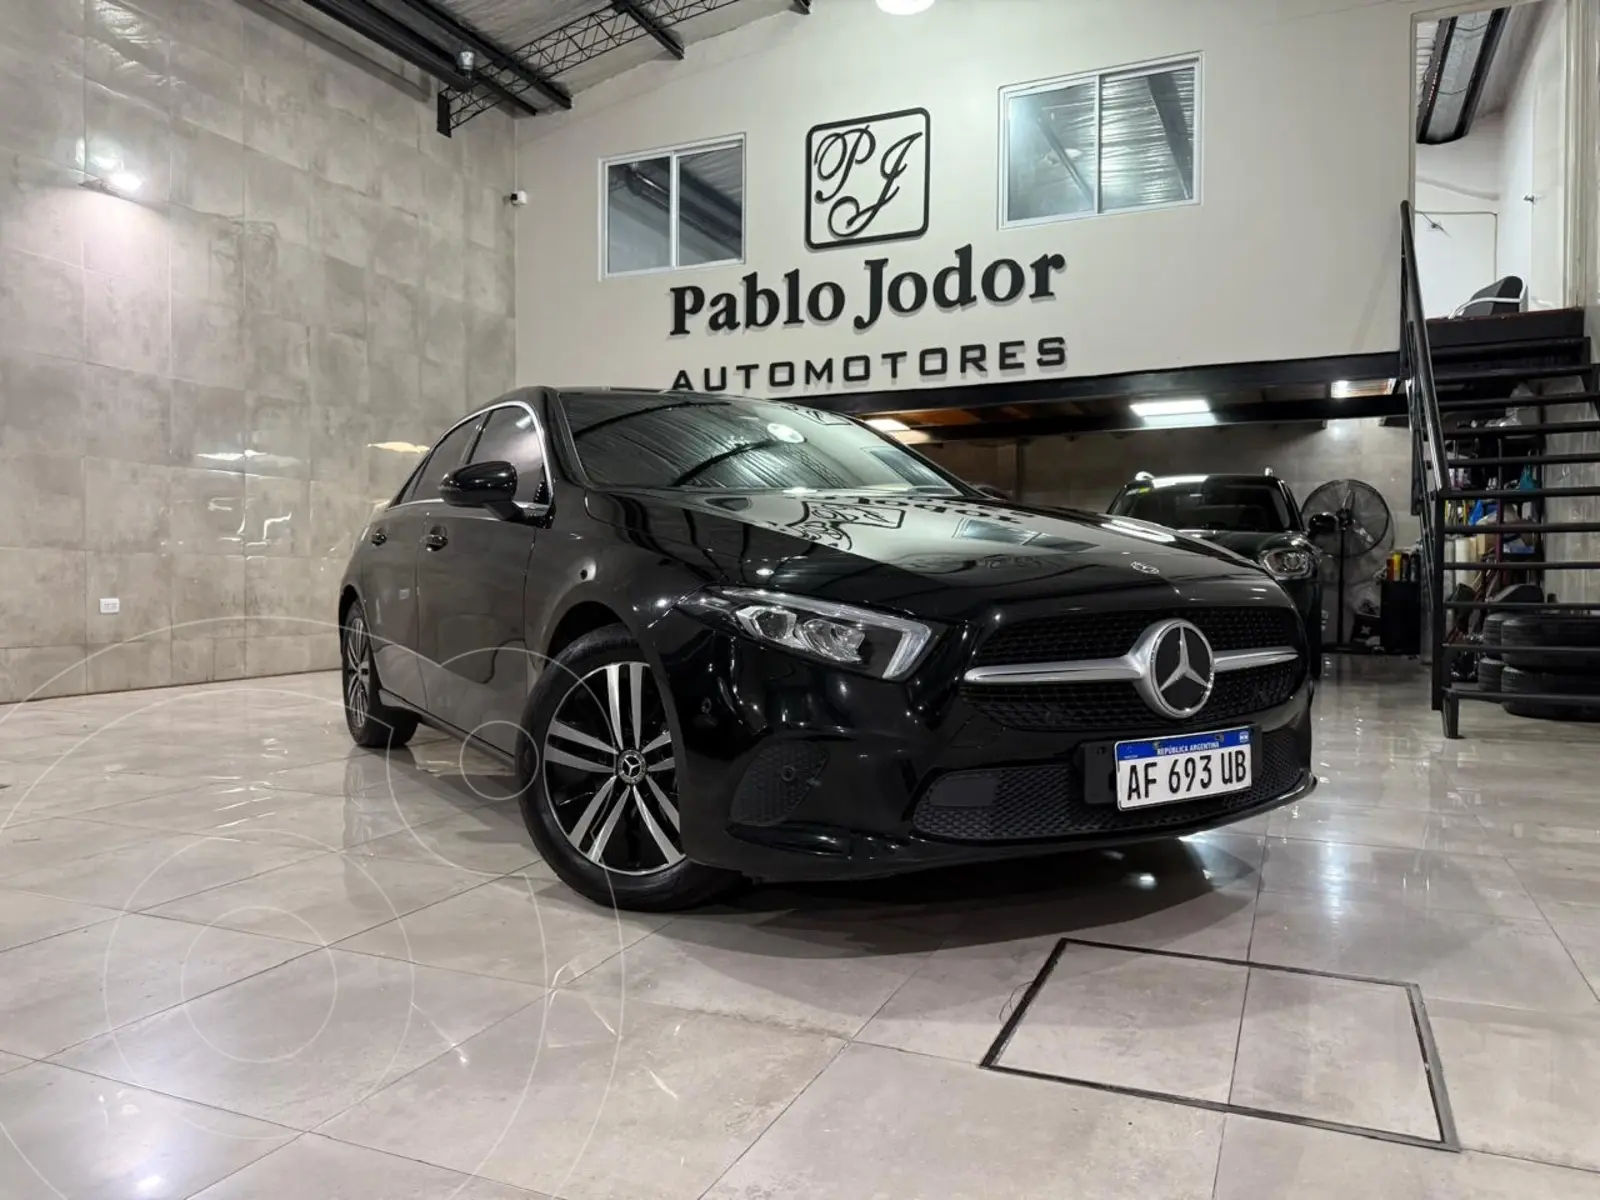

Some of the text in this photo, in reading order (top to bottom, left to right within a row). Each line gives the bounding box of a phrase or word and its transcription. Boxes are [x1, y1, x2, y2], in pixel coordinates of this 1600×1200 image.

[669, 243, 1066, 336] Pablo Jodor
[671, 336, 1067, 391] AUTOMOTORES
[1189, 741, 1220, 752] ARGENTINA
[1127, 749, 1247, 800] AF 693 UB
